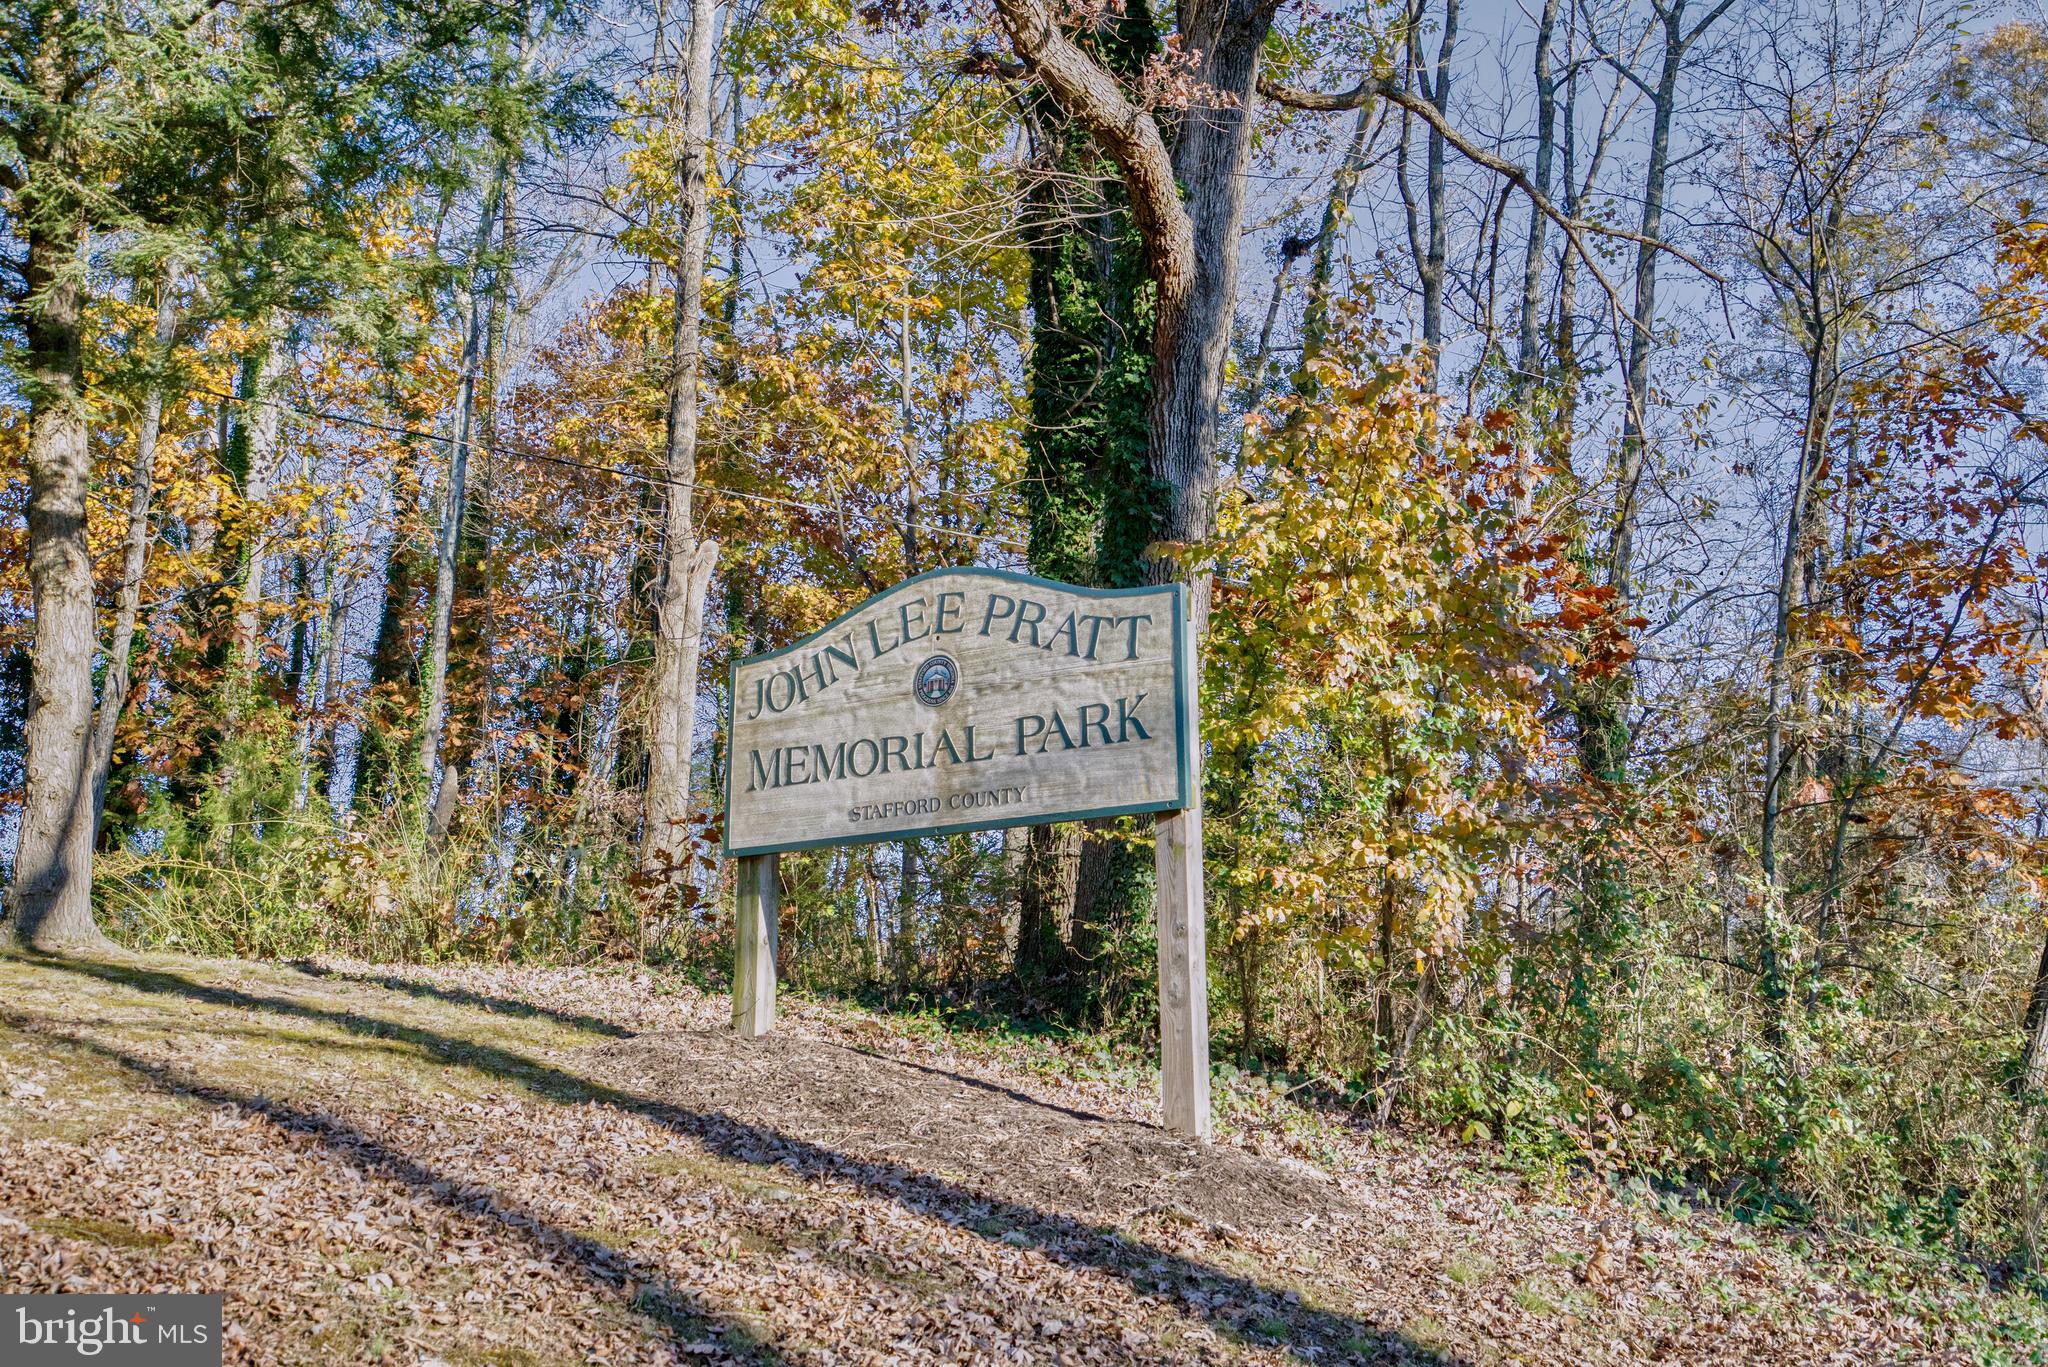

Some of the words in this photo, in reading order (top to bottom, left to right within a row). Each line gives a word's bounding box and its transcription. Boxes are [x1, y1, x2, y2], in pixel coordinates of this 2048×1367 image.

[748, 631, 859, 720] JOHN
[871, 591, 967, 658] LEE
[979, 593, 1153, 660] PRATT
[747, 724, 995, 792] MEMORIAL
[1015, 693, 1153, 756] PARK
[849, 796, 941, 822] STAFFORD
[949, 785, 1029, 810] COUNTY
